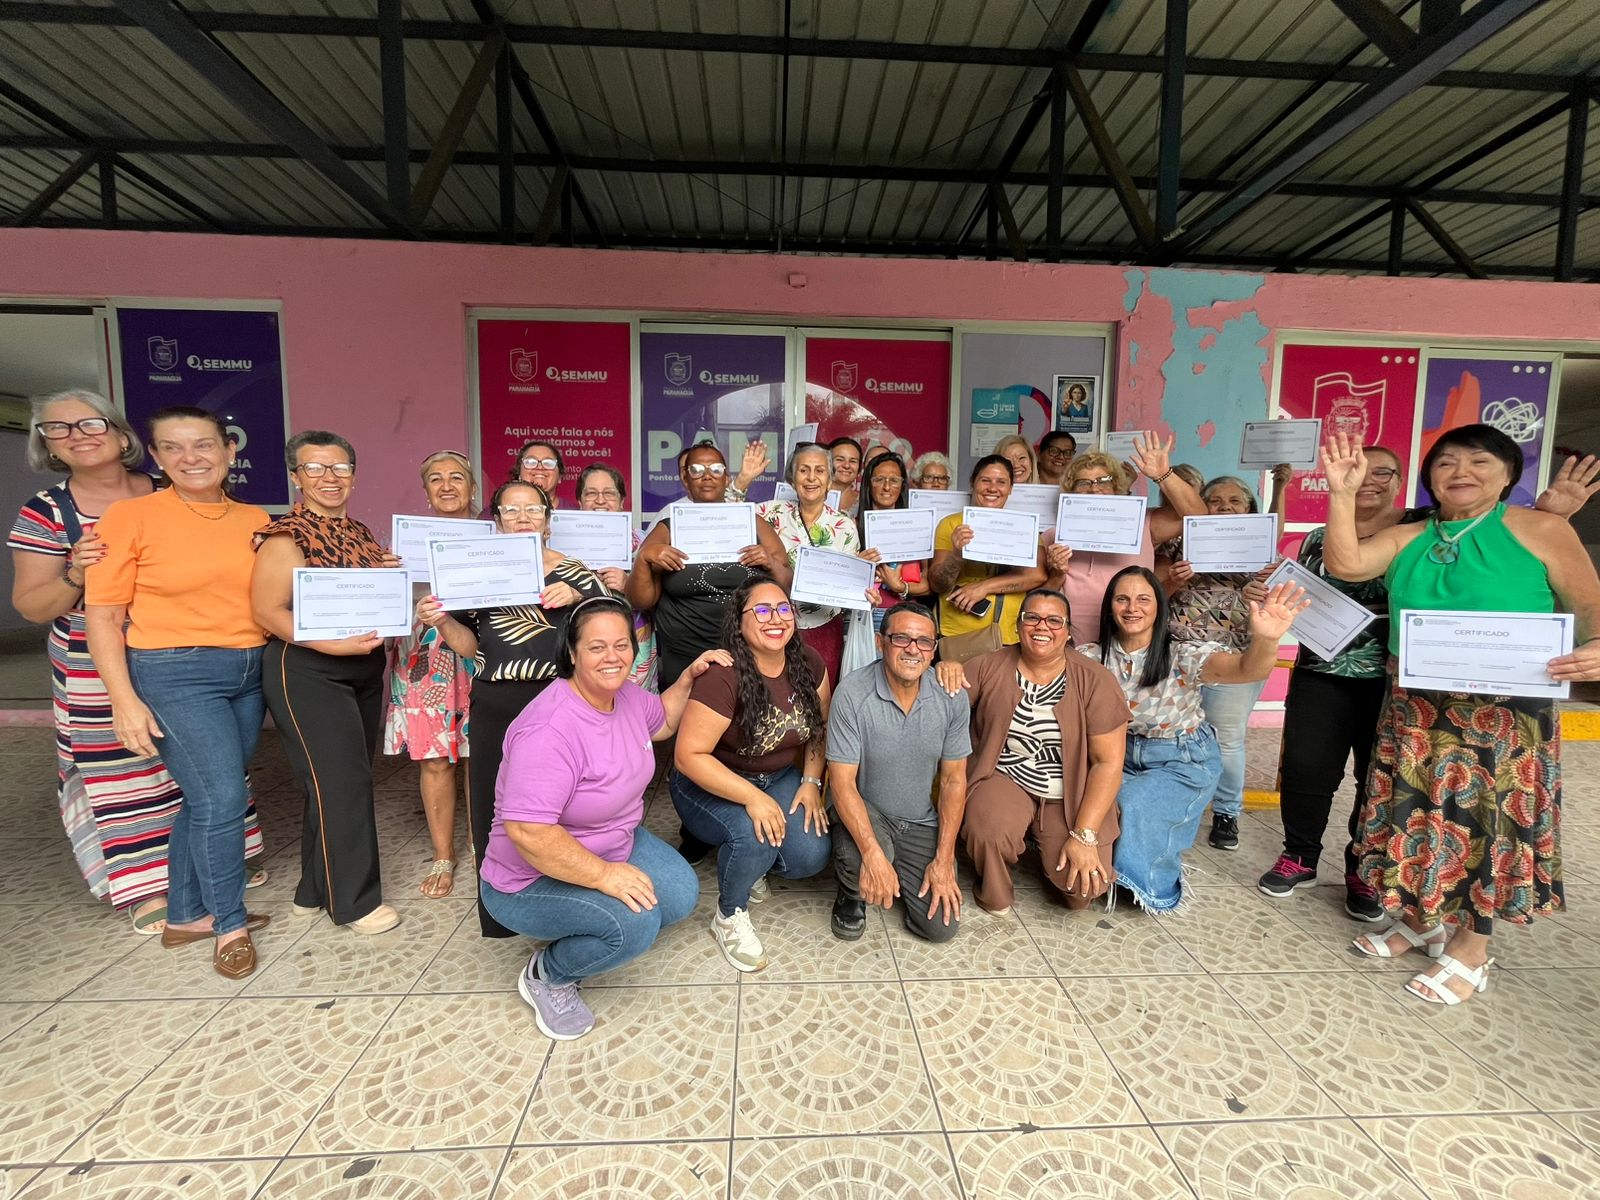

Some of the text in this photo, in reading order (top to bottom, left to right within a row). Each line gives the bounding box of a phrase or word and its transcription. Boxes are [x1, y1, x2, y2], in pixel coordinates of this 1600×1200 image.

[203, 359, 252, 369] SEMMU
[561, 370, 608, 380] SEMMU
[714, 374, 760, 383] SEMMU
[880, 382, 923, 391] SEMMU
[504, 426, 614, 437] Aqui você fala e nós
[588, 439, 595, 447] e
[565, 448, 611, 457] de você!
[1454, 629, 1510, 637] CERTIFICADO
